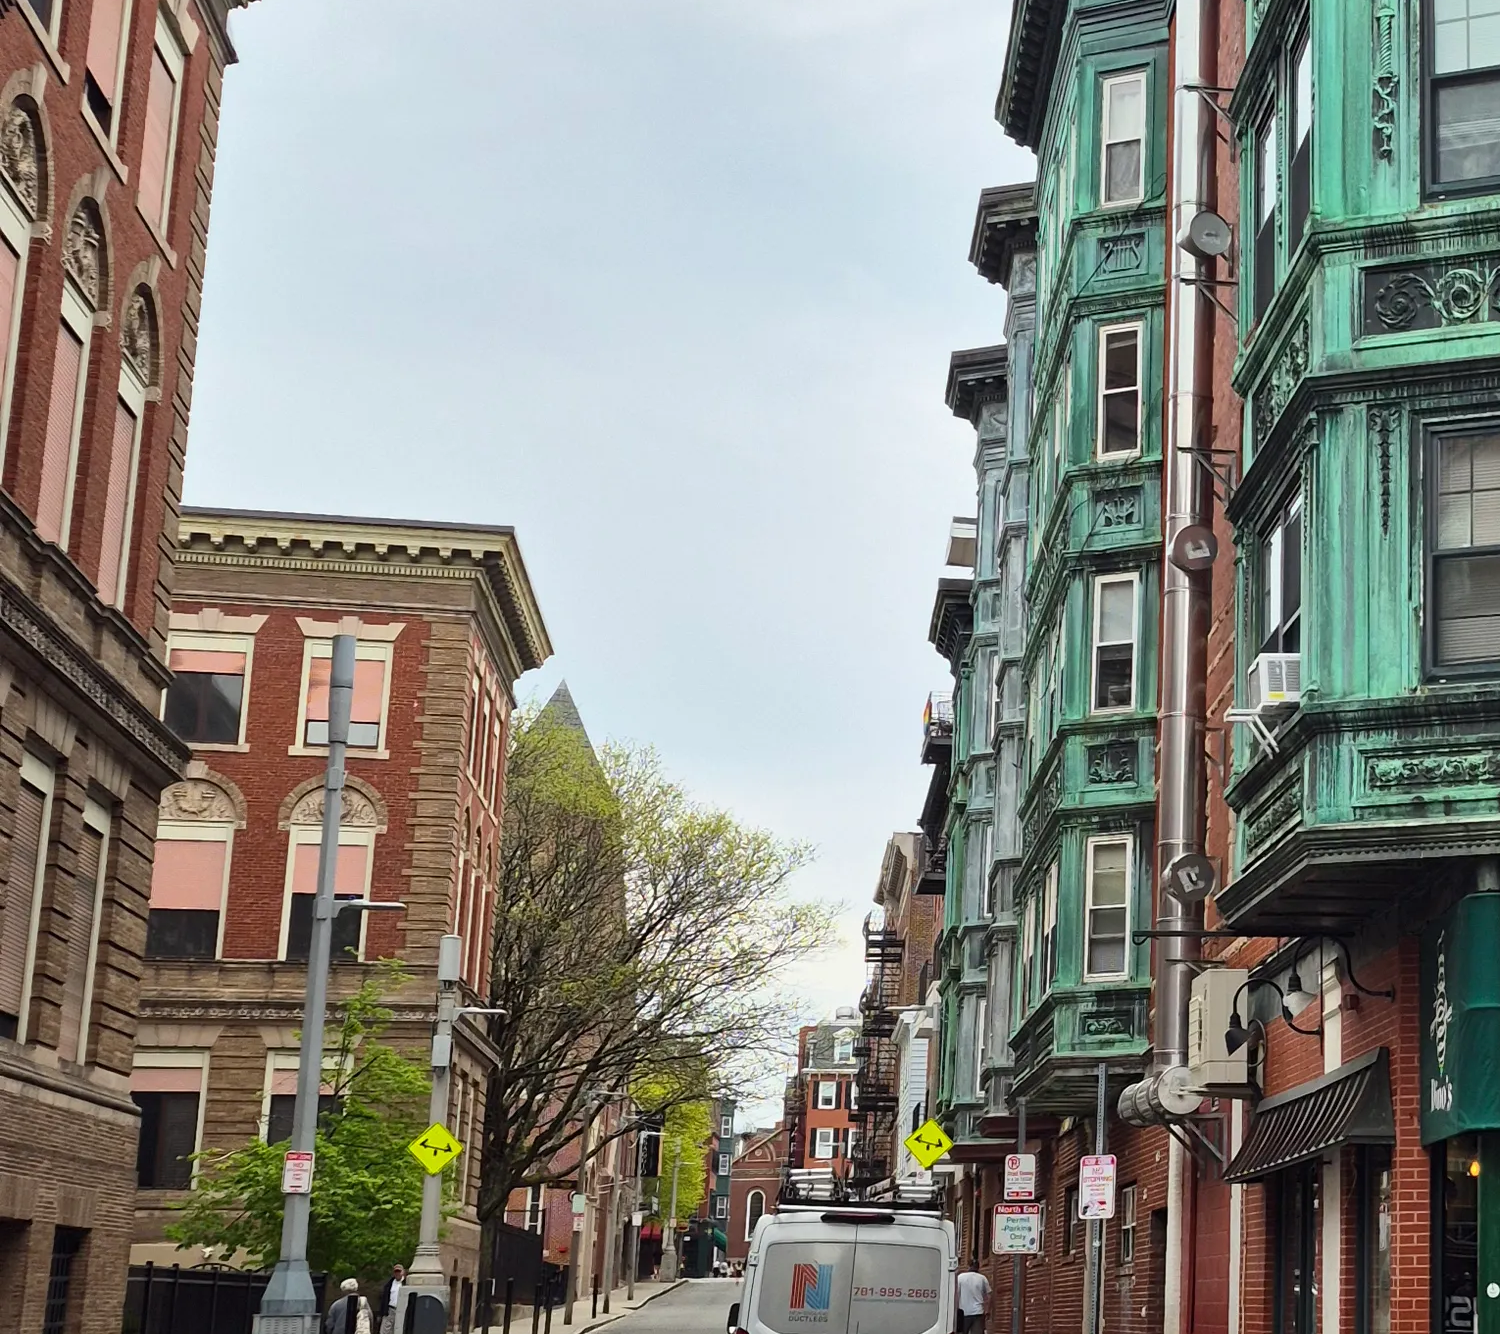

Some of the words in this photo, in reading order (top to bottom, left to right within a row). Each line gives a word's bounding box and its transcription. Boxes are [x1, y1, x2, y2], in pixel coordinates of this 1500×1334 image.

[1430, 1075, 1453, 1113] Dino's
[1092, 1167, 1104, 1175] NO
[854, 1287, 938, 1299] 781-995-2665
